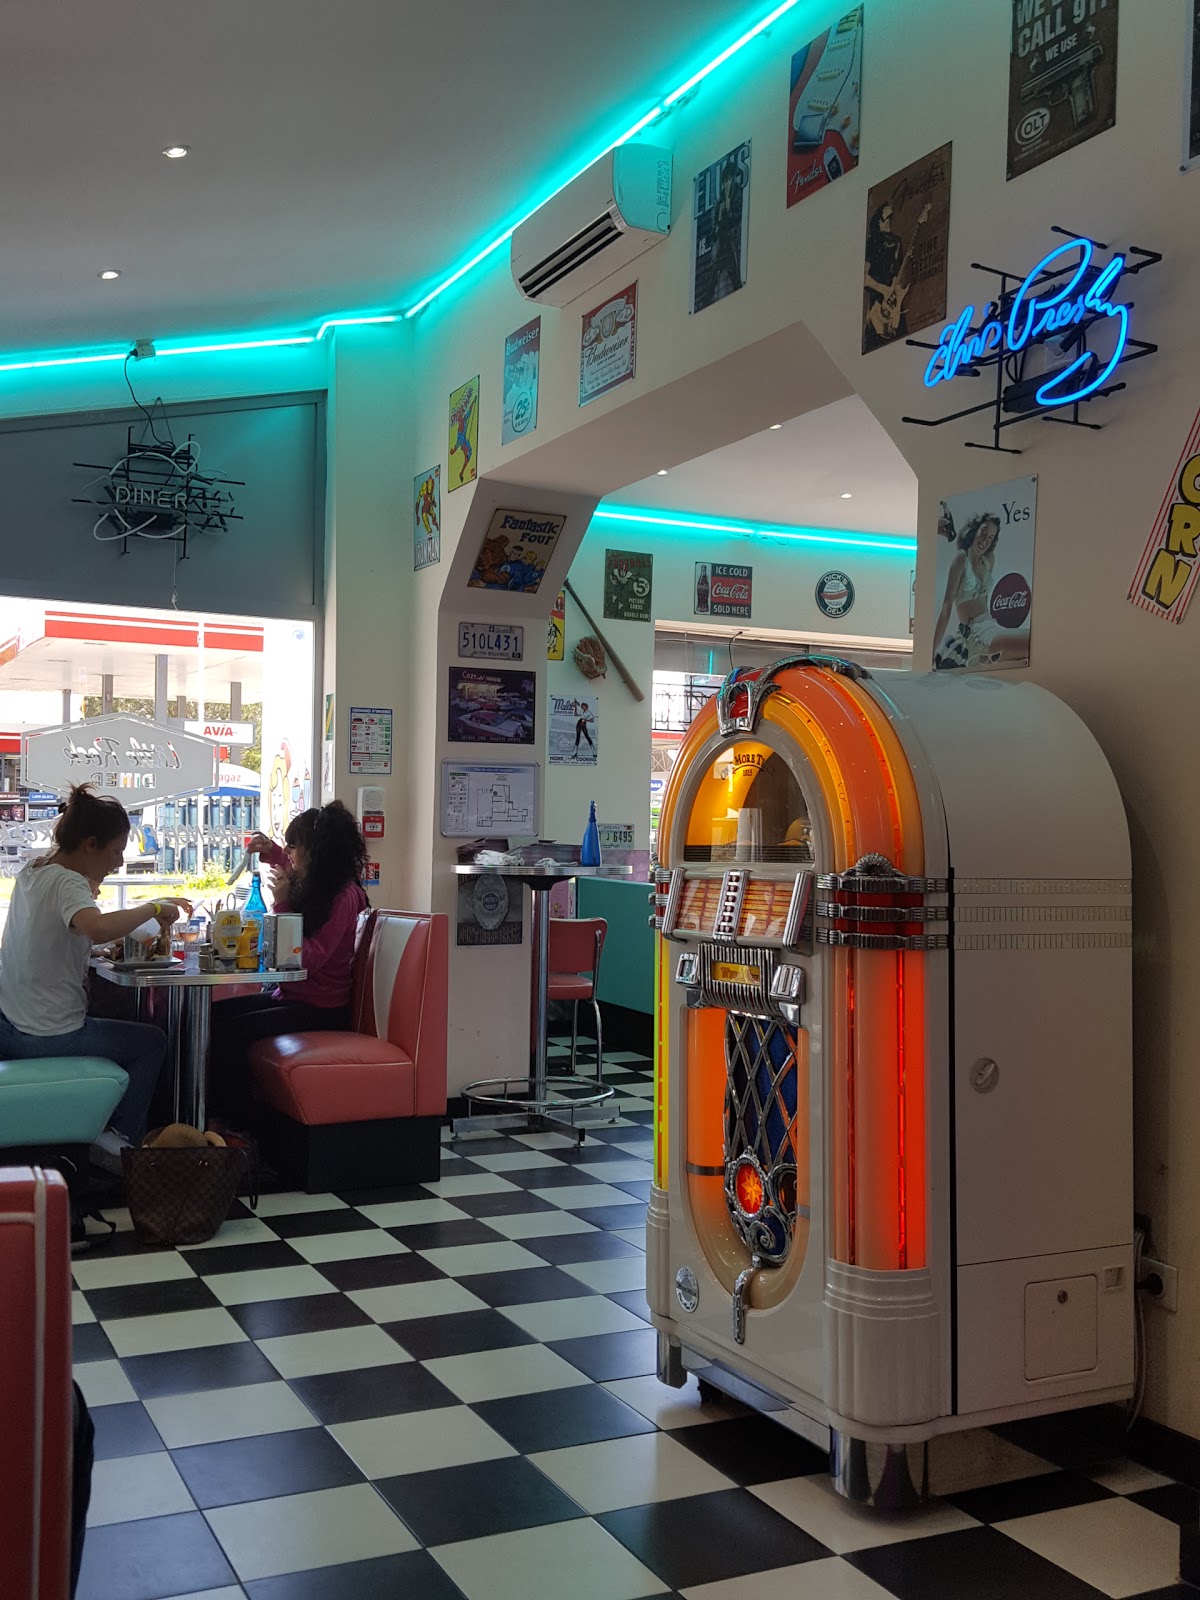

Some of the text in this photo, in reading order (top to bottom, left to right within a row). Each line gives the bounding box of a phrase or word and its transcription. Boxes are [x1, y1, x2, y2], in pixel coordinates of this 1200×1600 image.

[1018, 7, 1067, 58] CALL
[1045, 33, 1078, 60] WE USE
[789, 158, 823, 194] Fender
[924, 239, 1128, 405] Elvis Presley
[506, 328, 539, 357] Budweiser
[585, 336, 629, 367] Budweiser
[116, 486, 188, 510] DINER
[1002, 501, 1031, 524] Yes
[500, 514, 561, 534] Fantastic
[519, 530, 555, 546] Four
[715, 566, 748, 577] ICE COLD
[824, 573, 848, 586] DICK'S
[713, 605, 749, 615] SOLD HERE
[826, 606, 844, 615] DELI
[462, 632, 518, 652] 510L431
[734, 754, 755, 766] MORE
[613, 830, 633, 843] 6495
